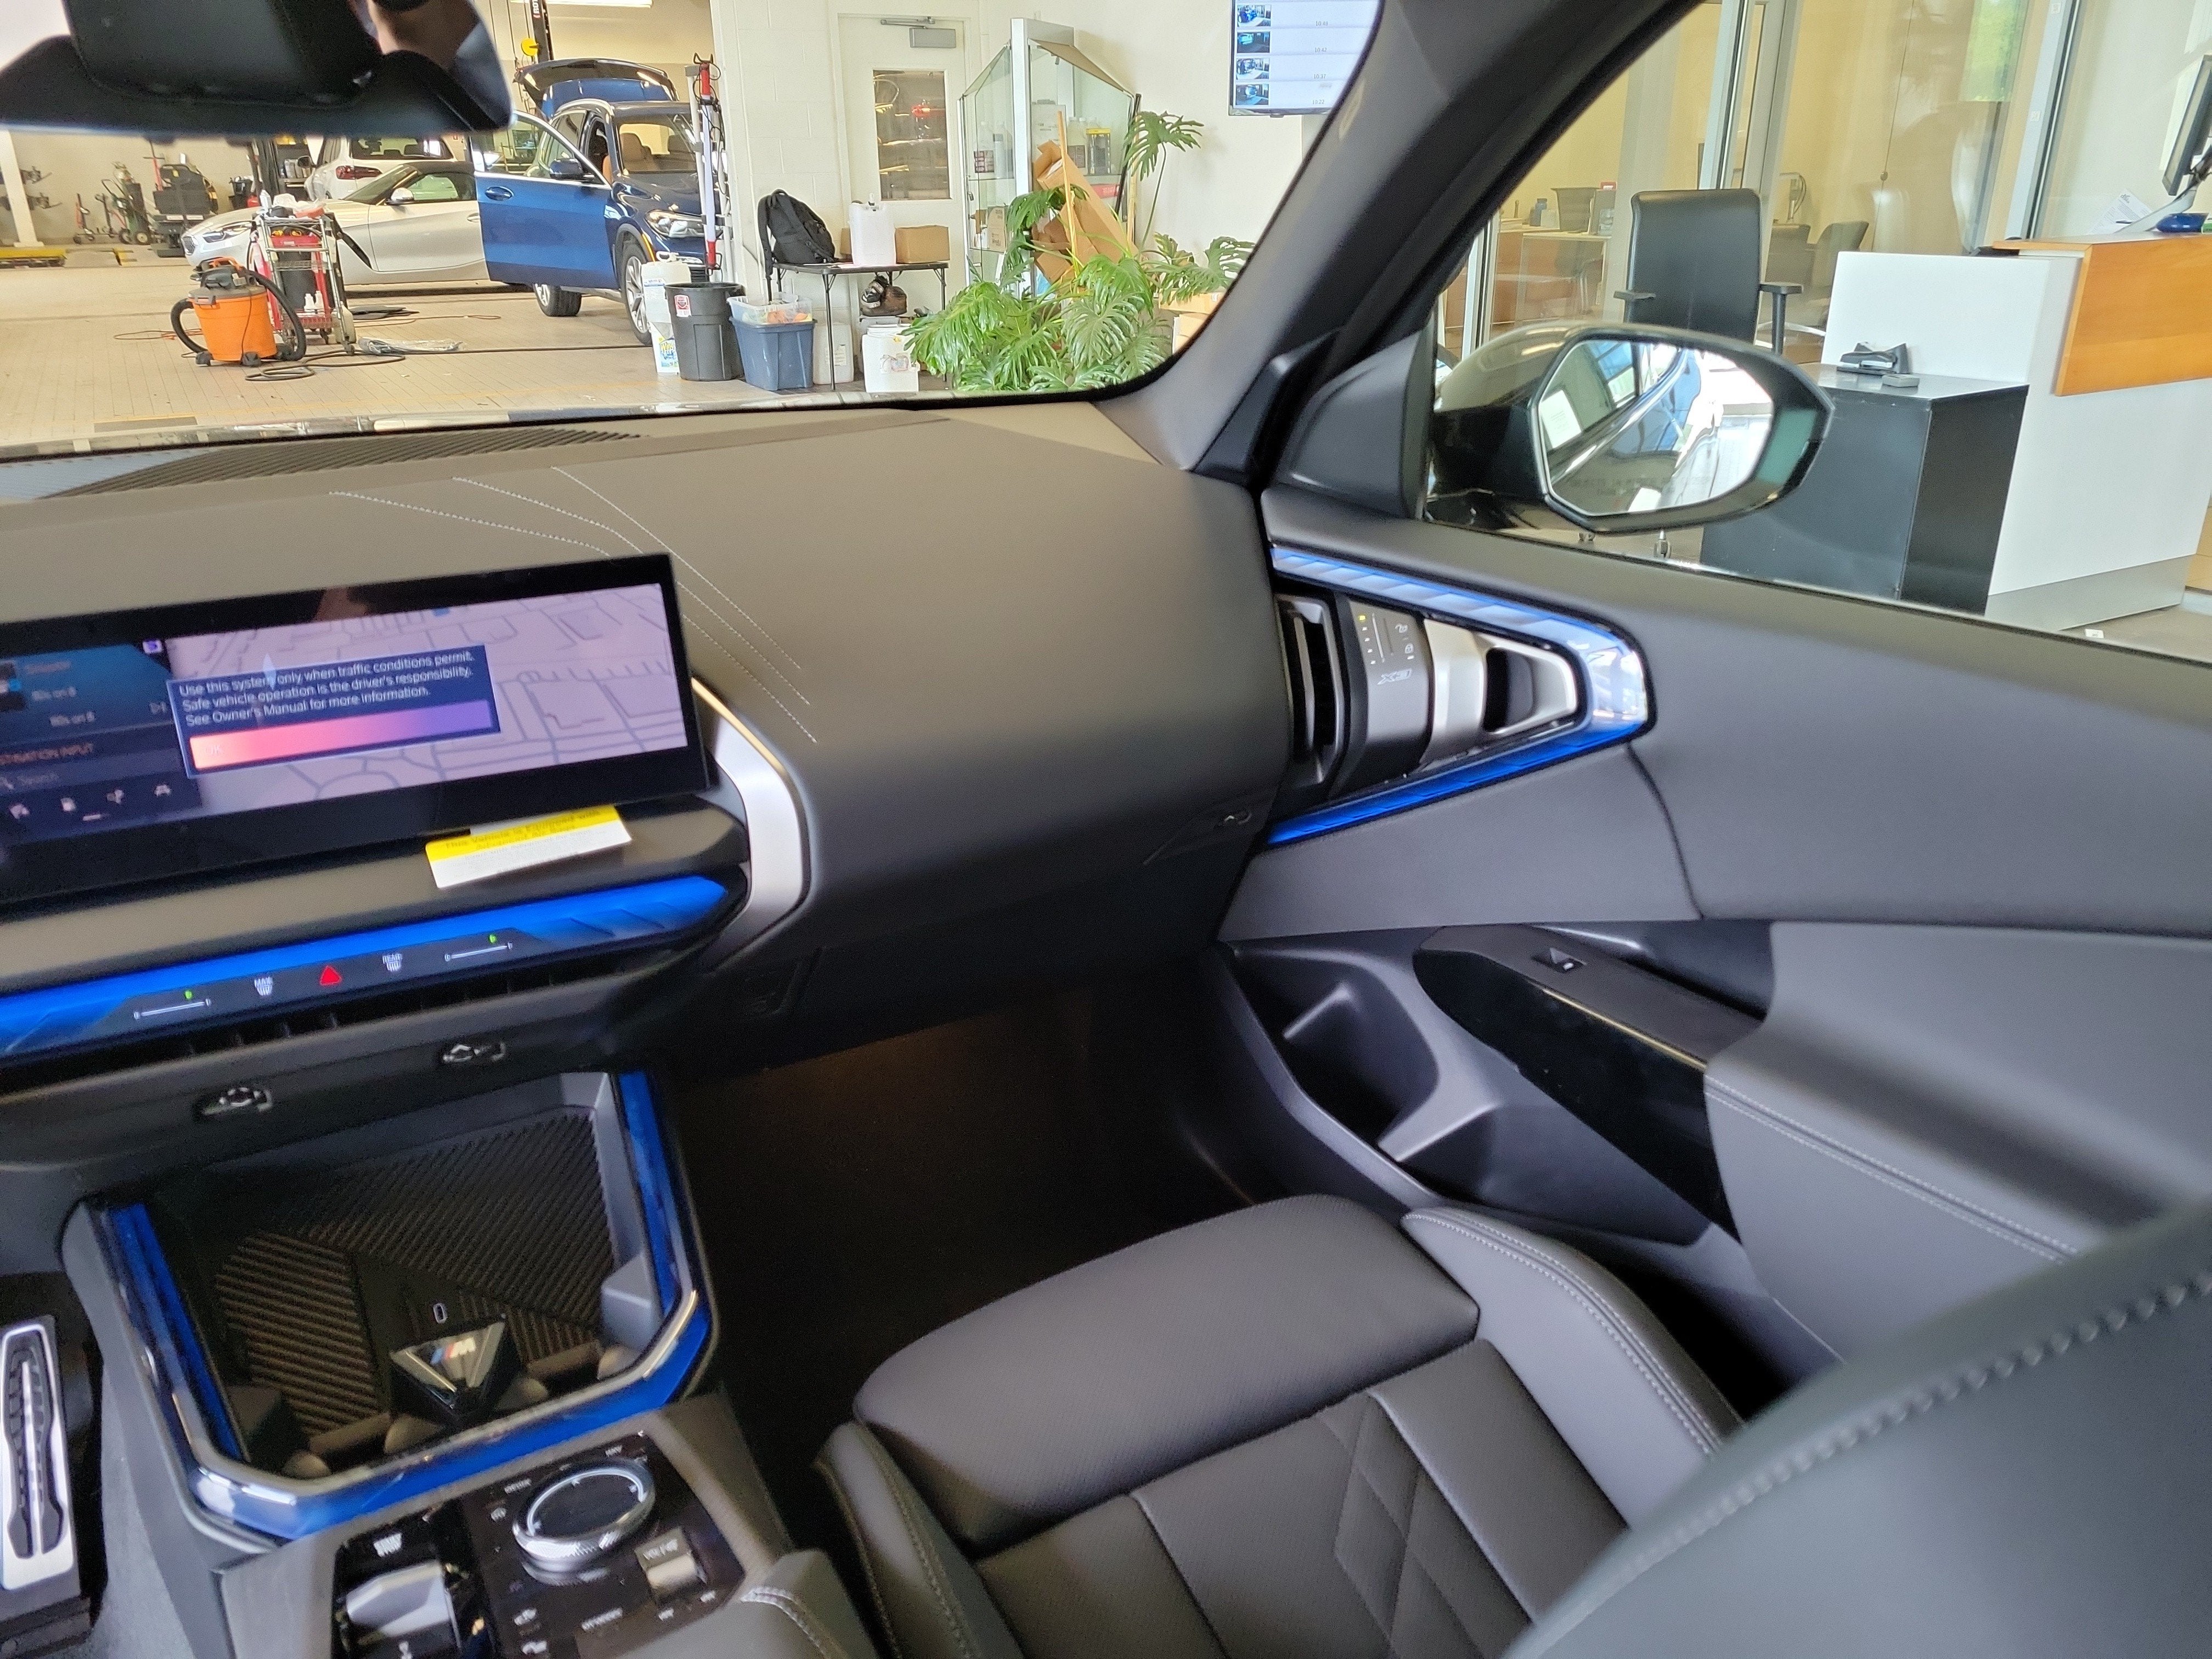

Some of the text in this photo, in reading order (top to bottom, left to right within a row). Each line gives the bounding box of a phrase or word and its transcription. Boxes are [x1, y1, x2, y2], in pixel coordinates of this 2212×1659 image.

[179, 685, 204, 697] Use
[206, 681, 229, 693] this
[277, 670, 301, 685] only
[304, 668, 337, 681] when
[338, 663, 372, 676] traffic
[373, 656, 433, 673] conditions
[435, 651, 475, 667] permit.
[183, 666, 473, 712] Safe vehicle operation is the driver's responsibility.
[185, 686, 431, 727] See Owner's Manual for more information.
